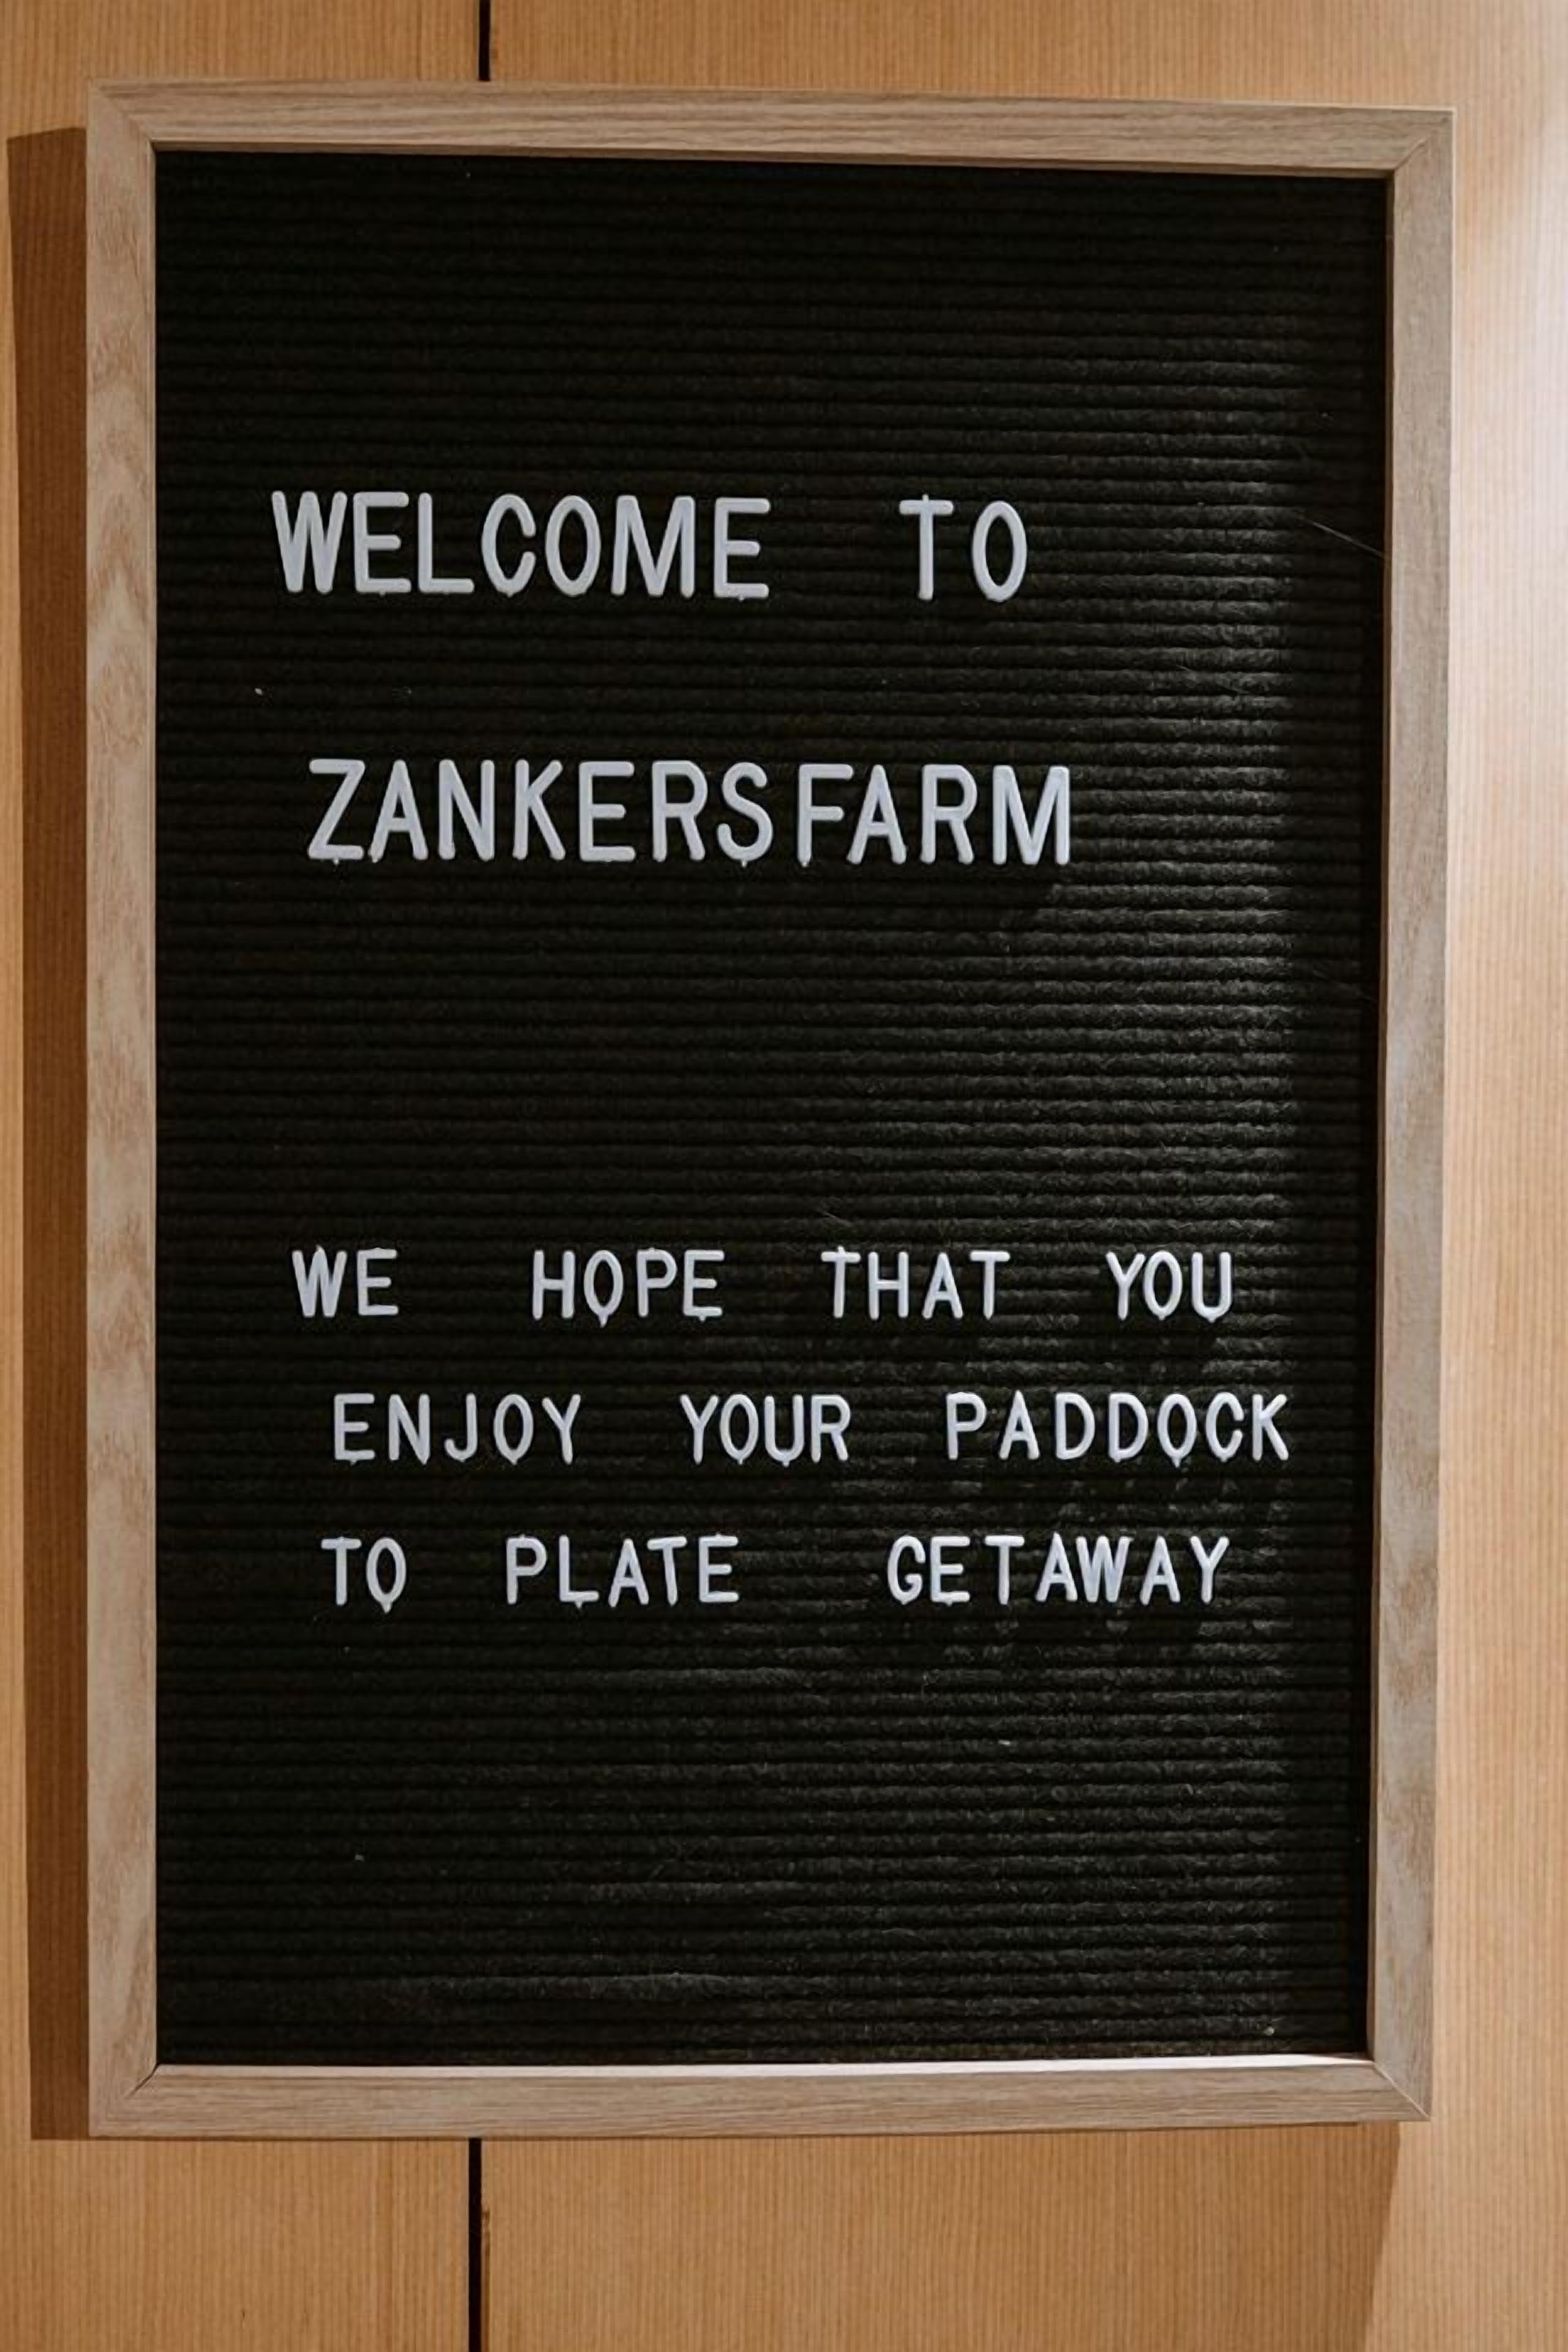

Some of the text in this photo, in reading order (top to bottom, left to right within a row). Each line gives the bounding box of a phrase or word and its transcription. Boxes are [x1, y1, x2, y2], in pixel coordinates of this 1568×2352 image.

[271, 491, 1028, 601] WELCOME TO
[292, 1245, 1232, 1327] WE HOPE THAT YOU
[334, 1389, 1289, 1468] ENJOY YOUR PADDOCK
[320, 1531, 1230, 1613] TO PLATE GETAWAY
